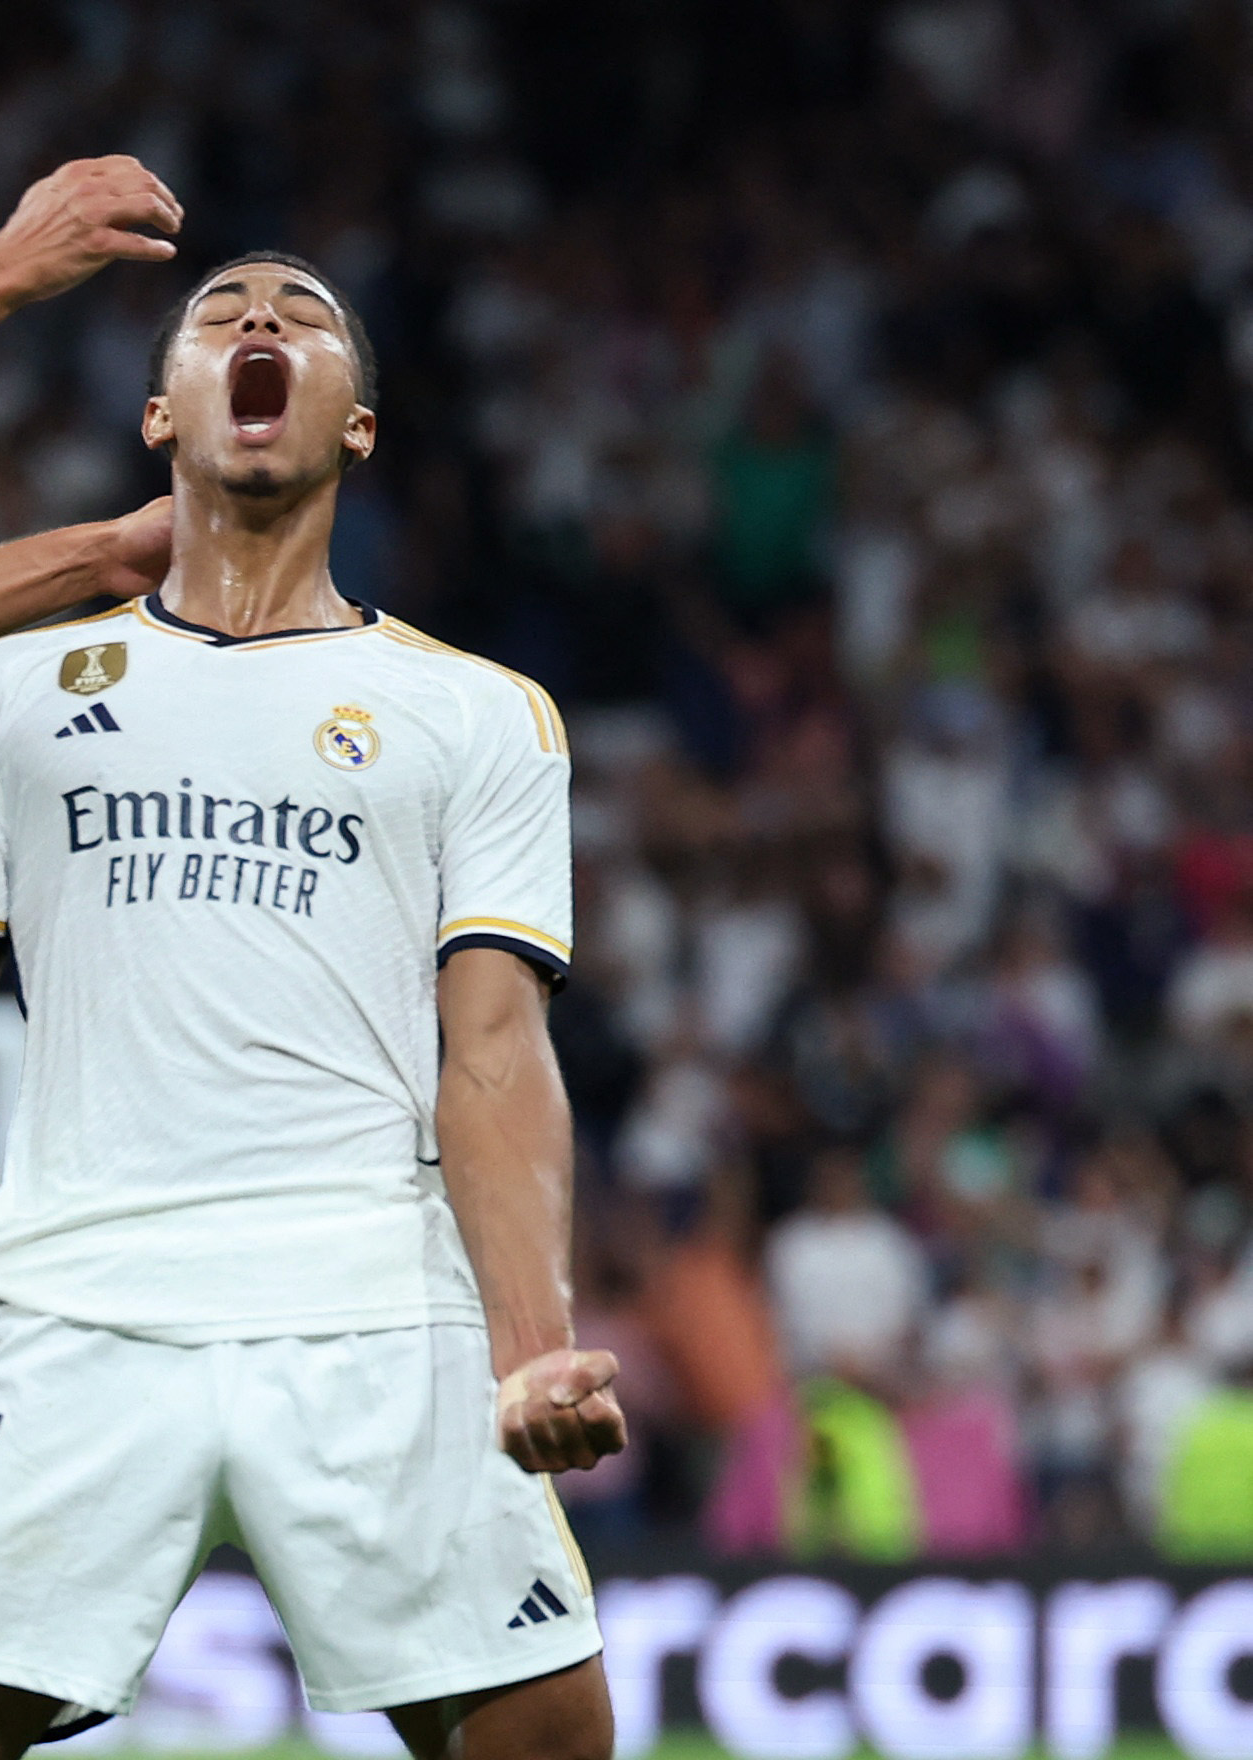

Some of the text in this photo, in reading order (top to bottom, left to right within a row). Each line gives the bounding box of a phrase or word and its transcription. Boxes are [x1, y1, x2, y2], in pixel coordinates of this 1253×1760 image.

[62, 777, 364, 864] Emirates
[106, 853, 318, 918] FLY BETTER
